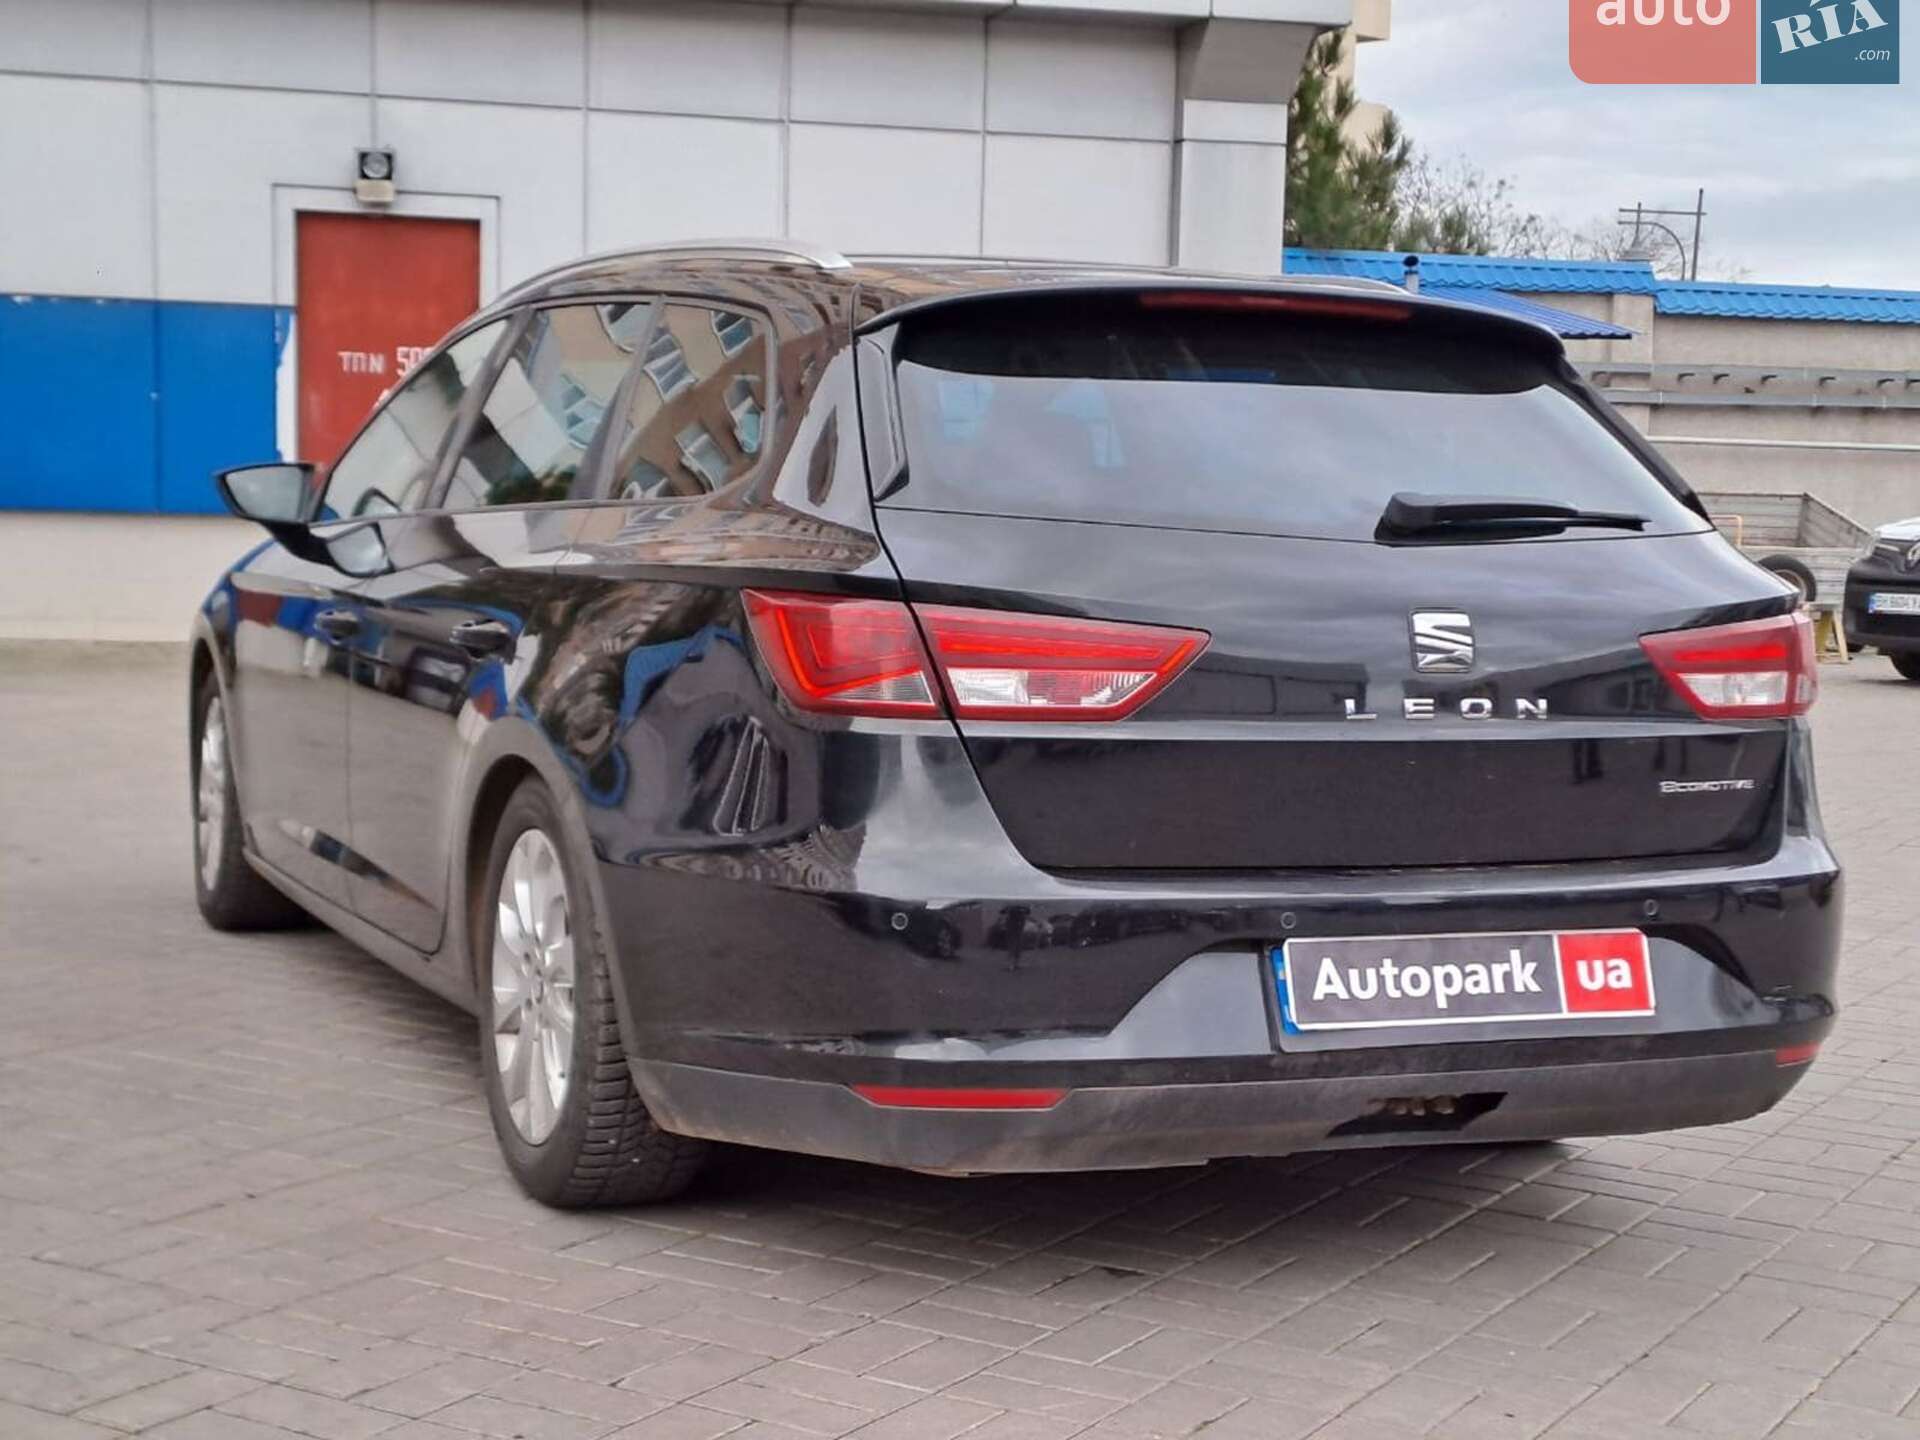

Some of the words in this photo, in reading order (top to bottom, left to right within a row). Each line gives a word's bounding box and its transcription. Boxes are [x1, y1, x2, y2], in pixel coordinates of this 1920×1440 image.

[1344, 698, 1549, 720] LEON
[1313, 950, 1542, 1008] Autopark
[1576, 957, 1632, 991] ua
